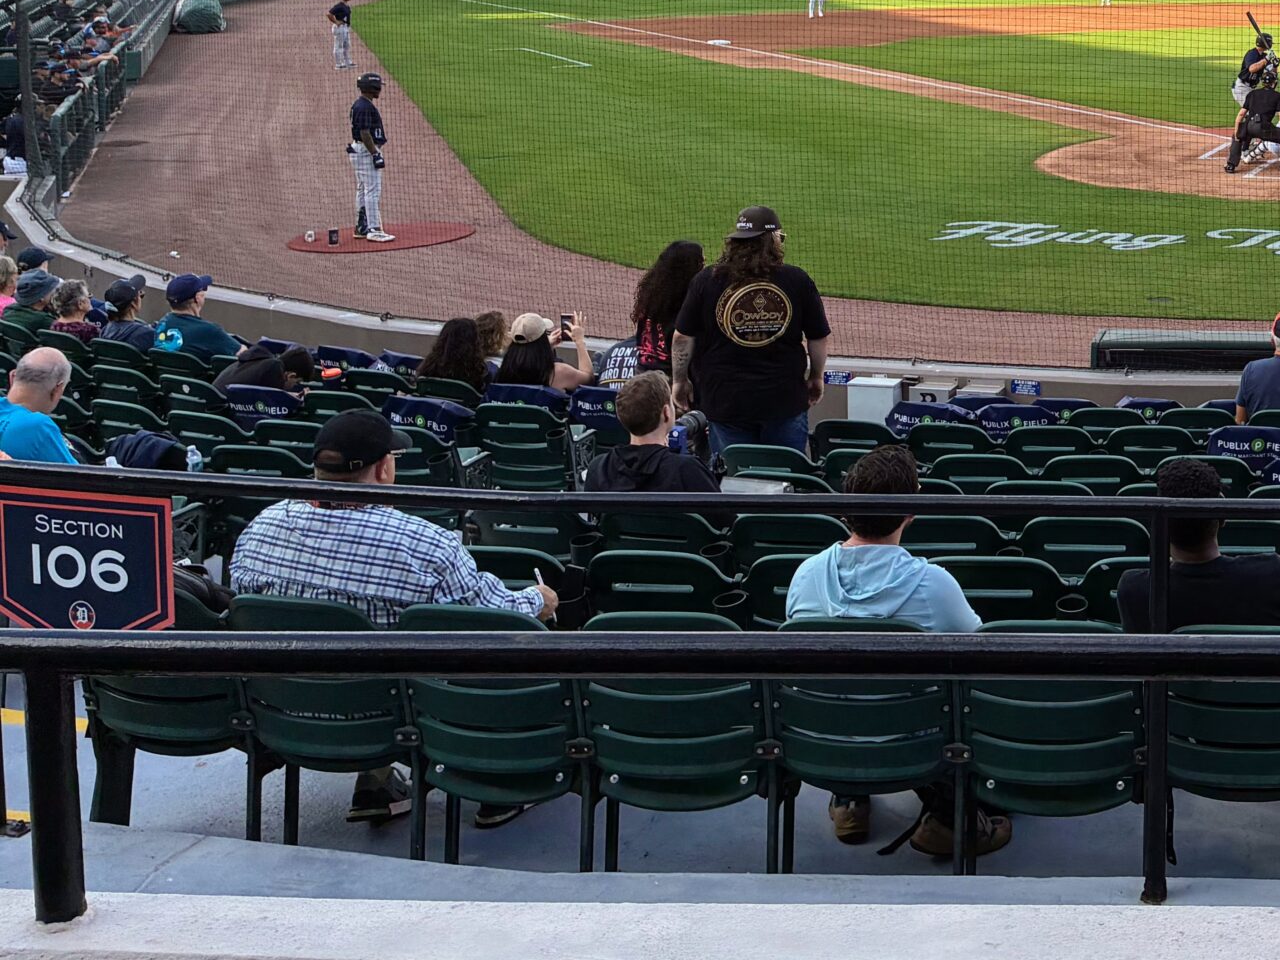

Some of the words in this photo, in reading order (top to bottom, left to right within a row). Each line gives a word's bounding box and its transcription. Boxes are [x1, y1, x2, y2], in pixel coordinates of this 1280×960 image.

[932, 220, 1186, 251] Flying
[731, 309, 784, 326] Cowboy
[606, 357, 622, 368] LET
[623, 356, 638, 367] TH
[577, 400, 603, 411] PUBLIX
[894, 413, 921, 424] PUBLIX
[1023, 419, 1048, 427] FIELD
[1217, 439, 1250, 451] PUBLIX
[34, 514, 123, 539] SECTION
[31, 543, 129, 593] 106
